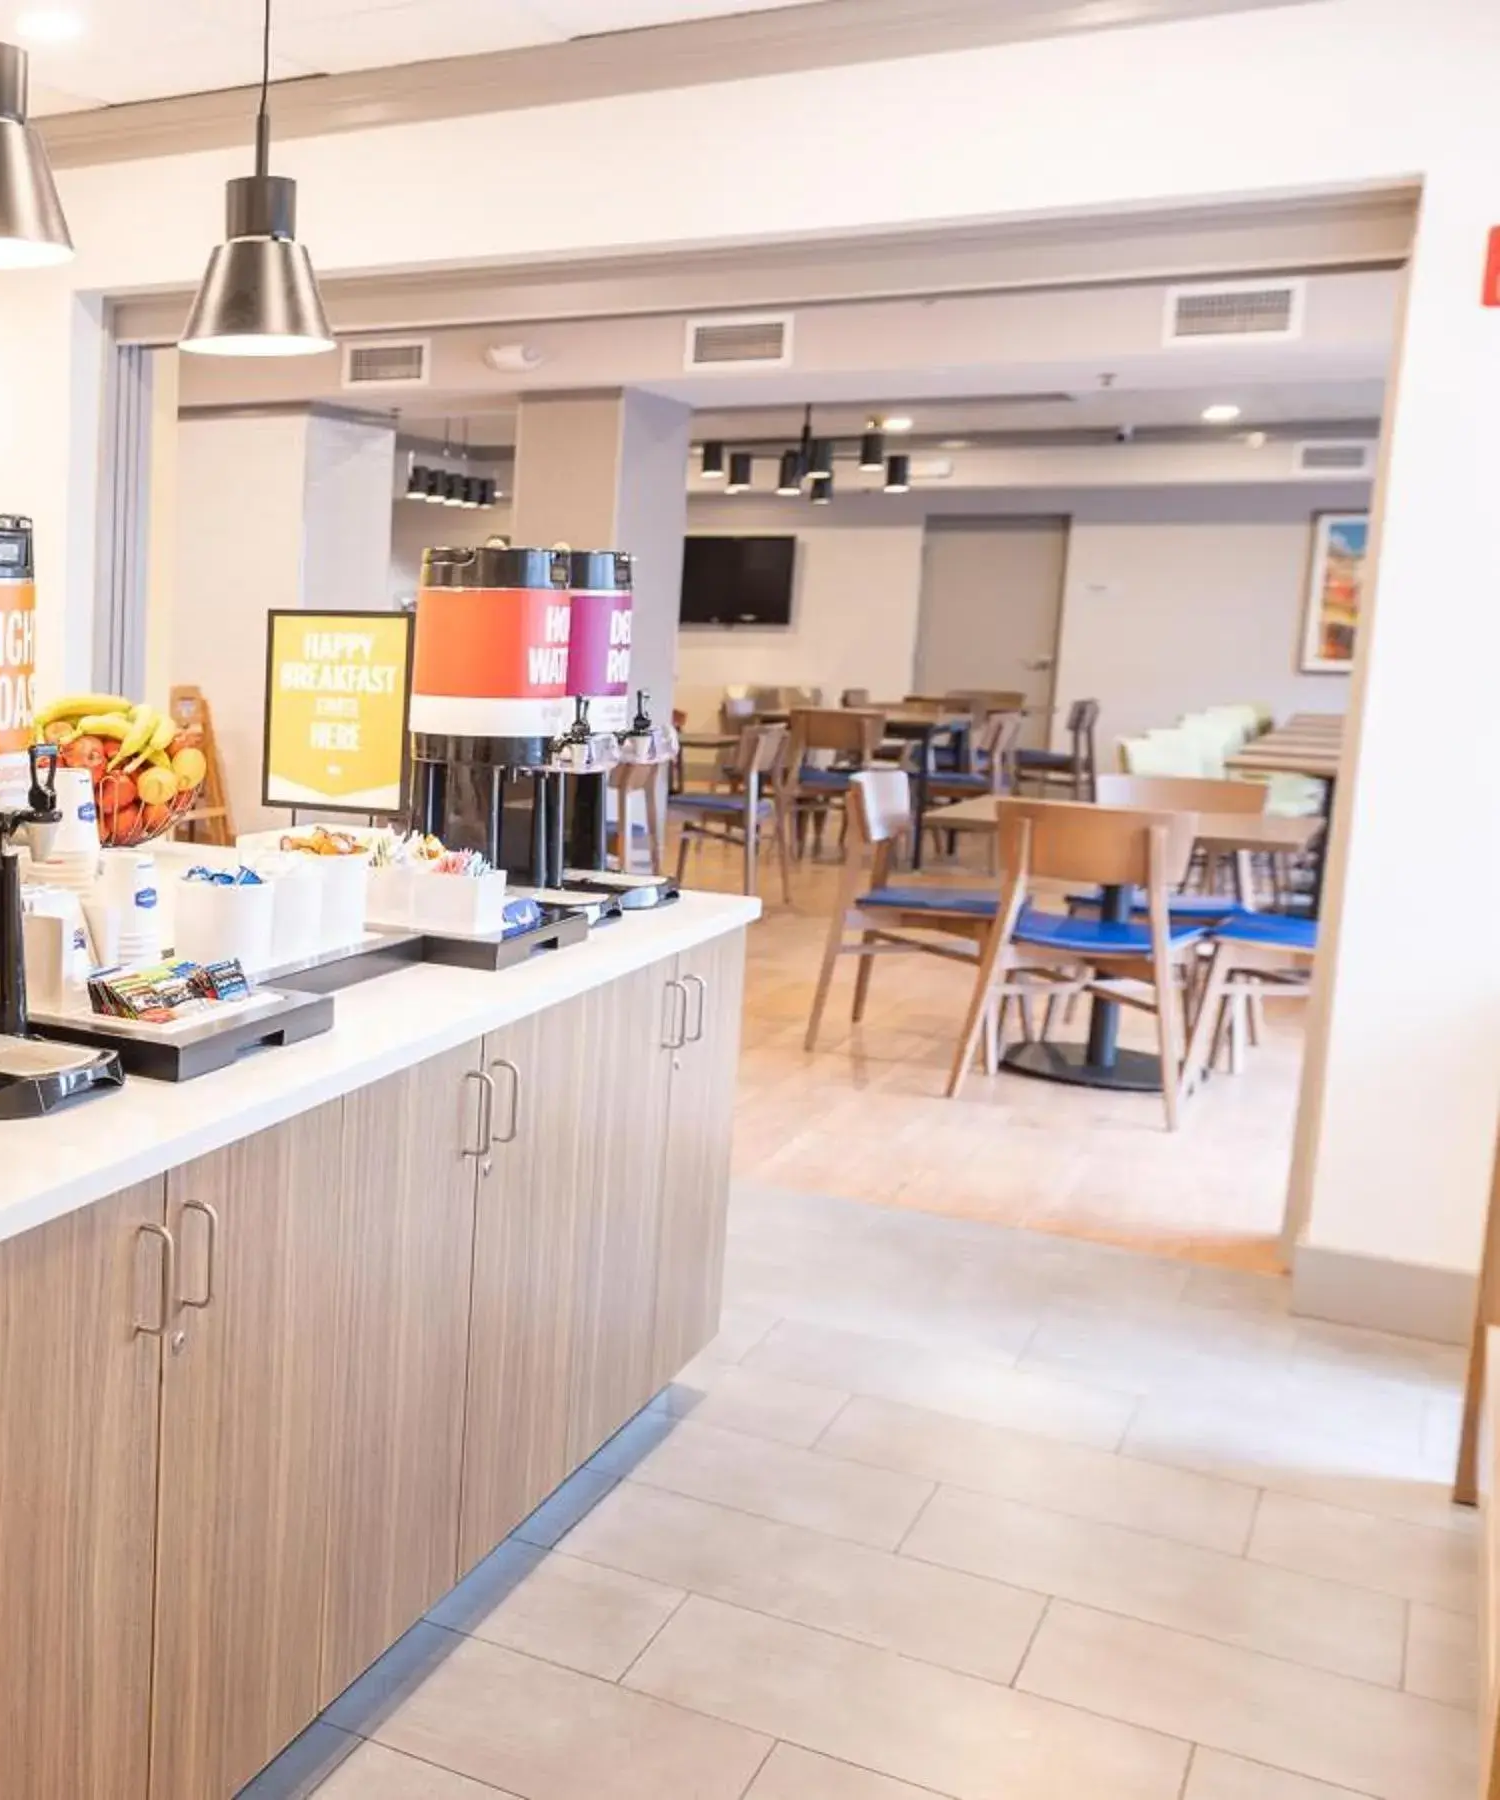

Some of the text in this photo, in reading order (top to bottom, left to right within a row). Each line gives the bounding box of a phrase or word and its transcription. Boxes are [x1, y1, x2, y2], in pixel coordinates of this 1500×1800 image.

[304, 631, 374, 663] HAPPY
[280, 661, 397, 693] BREAKFAST
[310, 721, 361, 752] HERE
